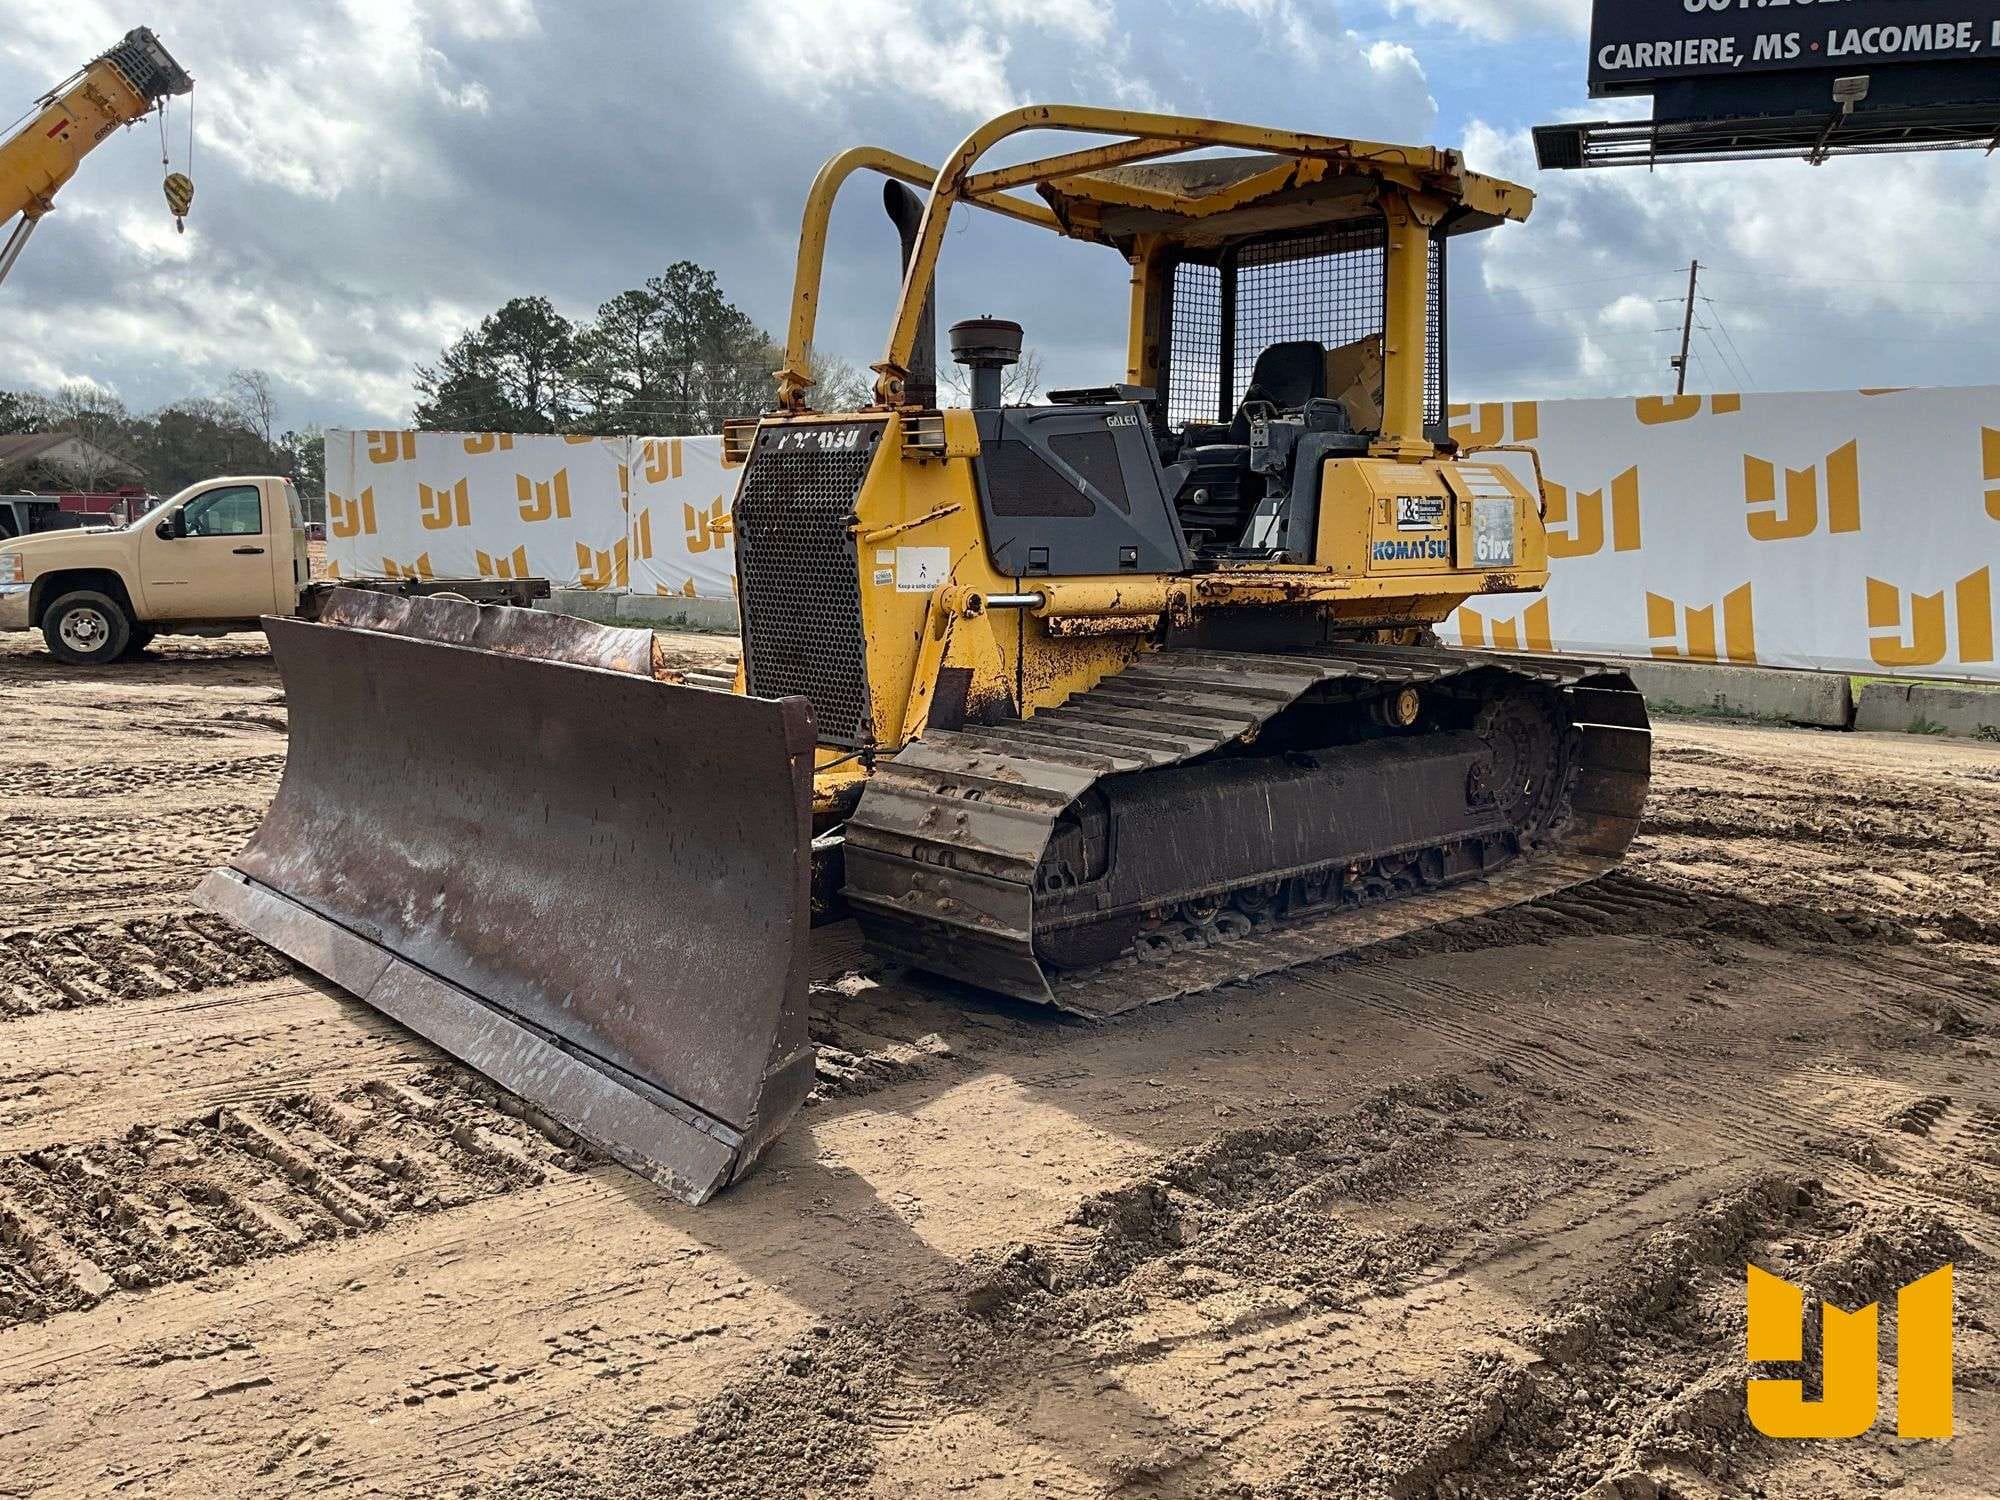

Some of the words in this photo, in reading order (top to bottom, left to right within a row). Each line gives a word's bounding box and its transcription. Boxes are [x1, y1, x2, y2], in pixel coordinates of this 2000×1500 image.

[1598, 38, 1744, 69] CARRIERE,
[1753, 33, 1800, 60] MS
[1827, 21, 1981, 56] LACOMBE,
[1106, 415, 1138, 427] GALEO
[1373, 536, 1446, 560] KOMATSU
